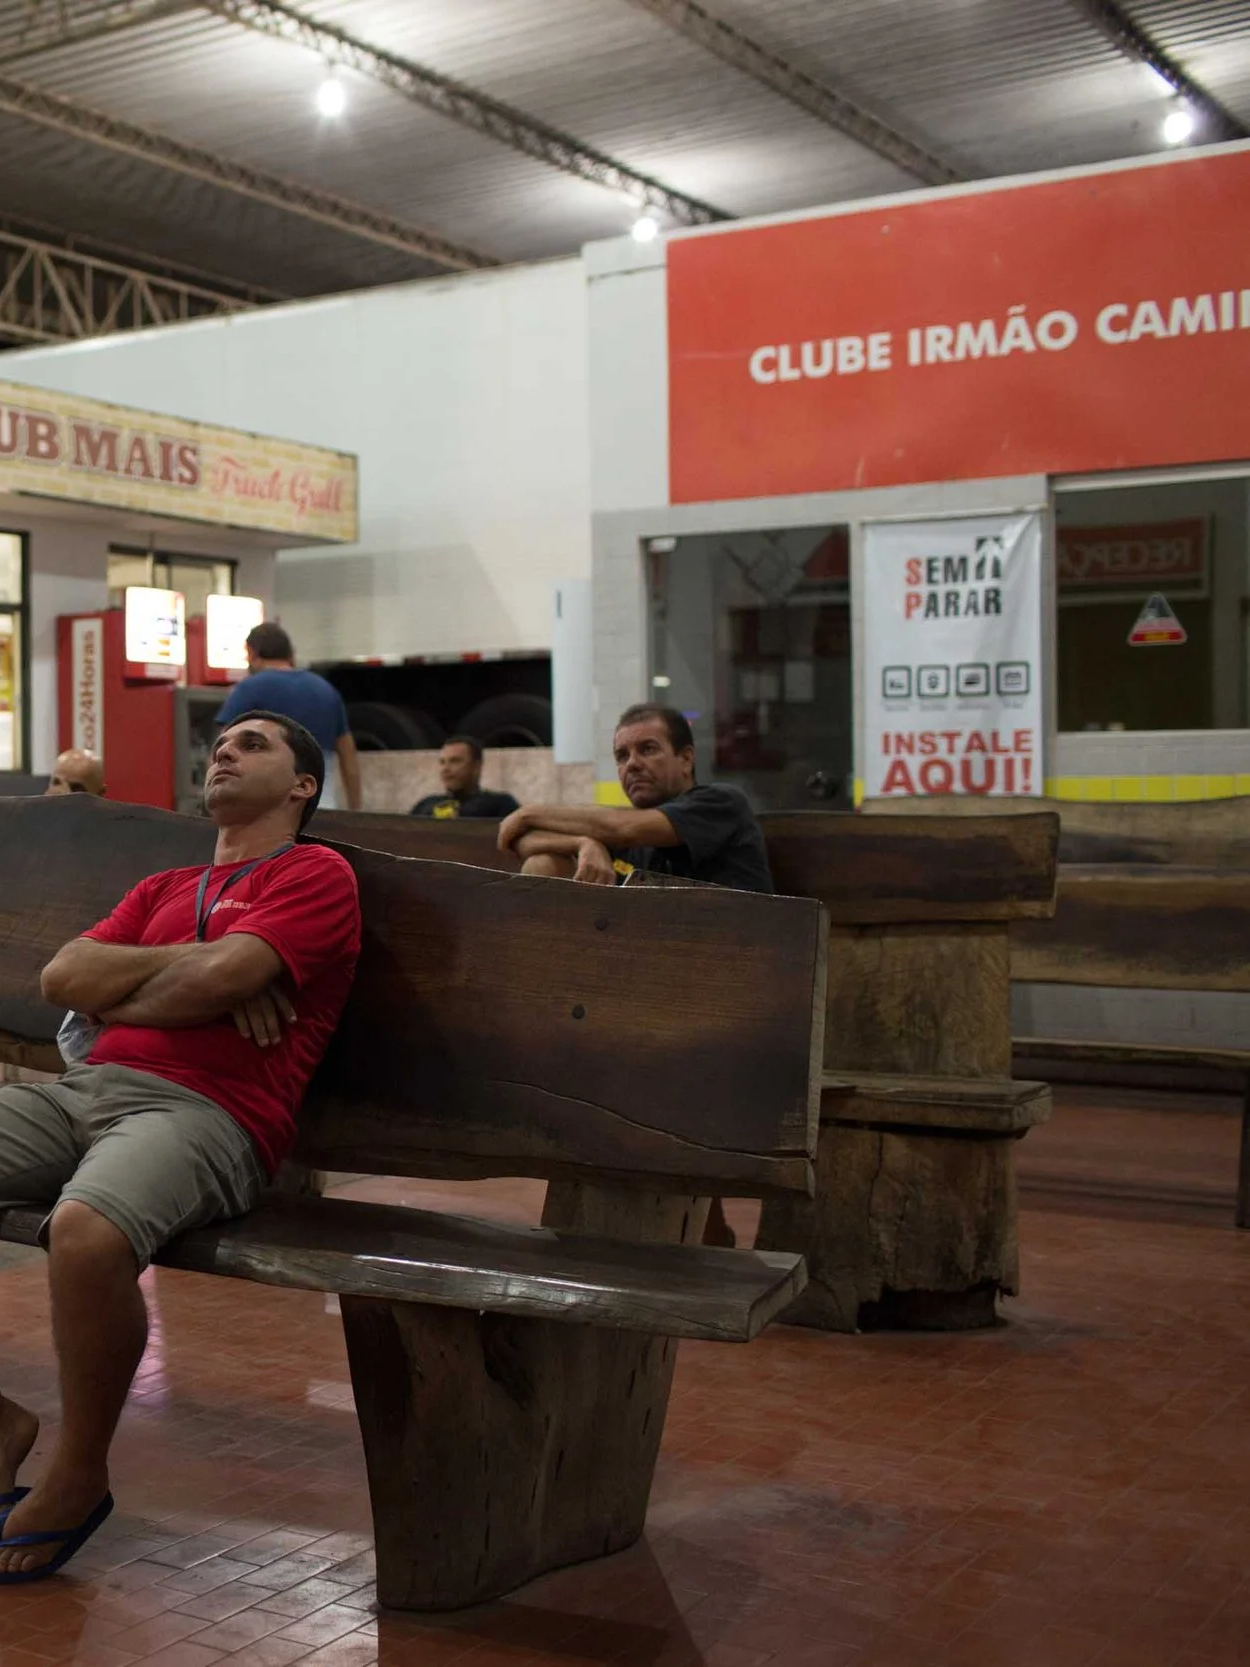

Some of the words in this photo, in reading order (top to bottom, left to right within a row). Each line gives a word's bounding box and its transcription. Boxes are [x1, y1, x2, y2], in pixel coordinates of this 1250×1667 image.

[750, 332, 892, 384] CLUBE
[908, 304, 1078, 366] IRMÃO
[72, 424, 200, 486] MAIS
[210, 454, 281, 502] Truck
[288, 468, 343, 519] Grill
[905, 556, 969, 586] SEM
[905, 587, 1002, 620] PARAR
[881, 728, 1033, 754] INSTALE
[881, 757, 1032, 795] AQUI!
